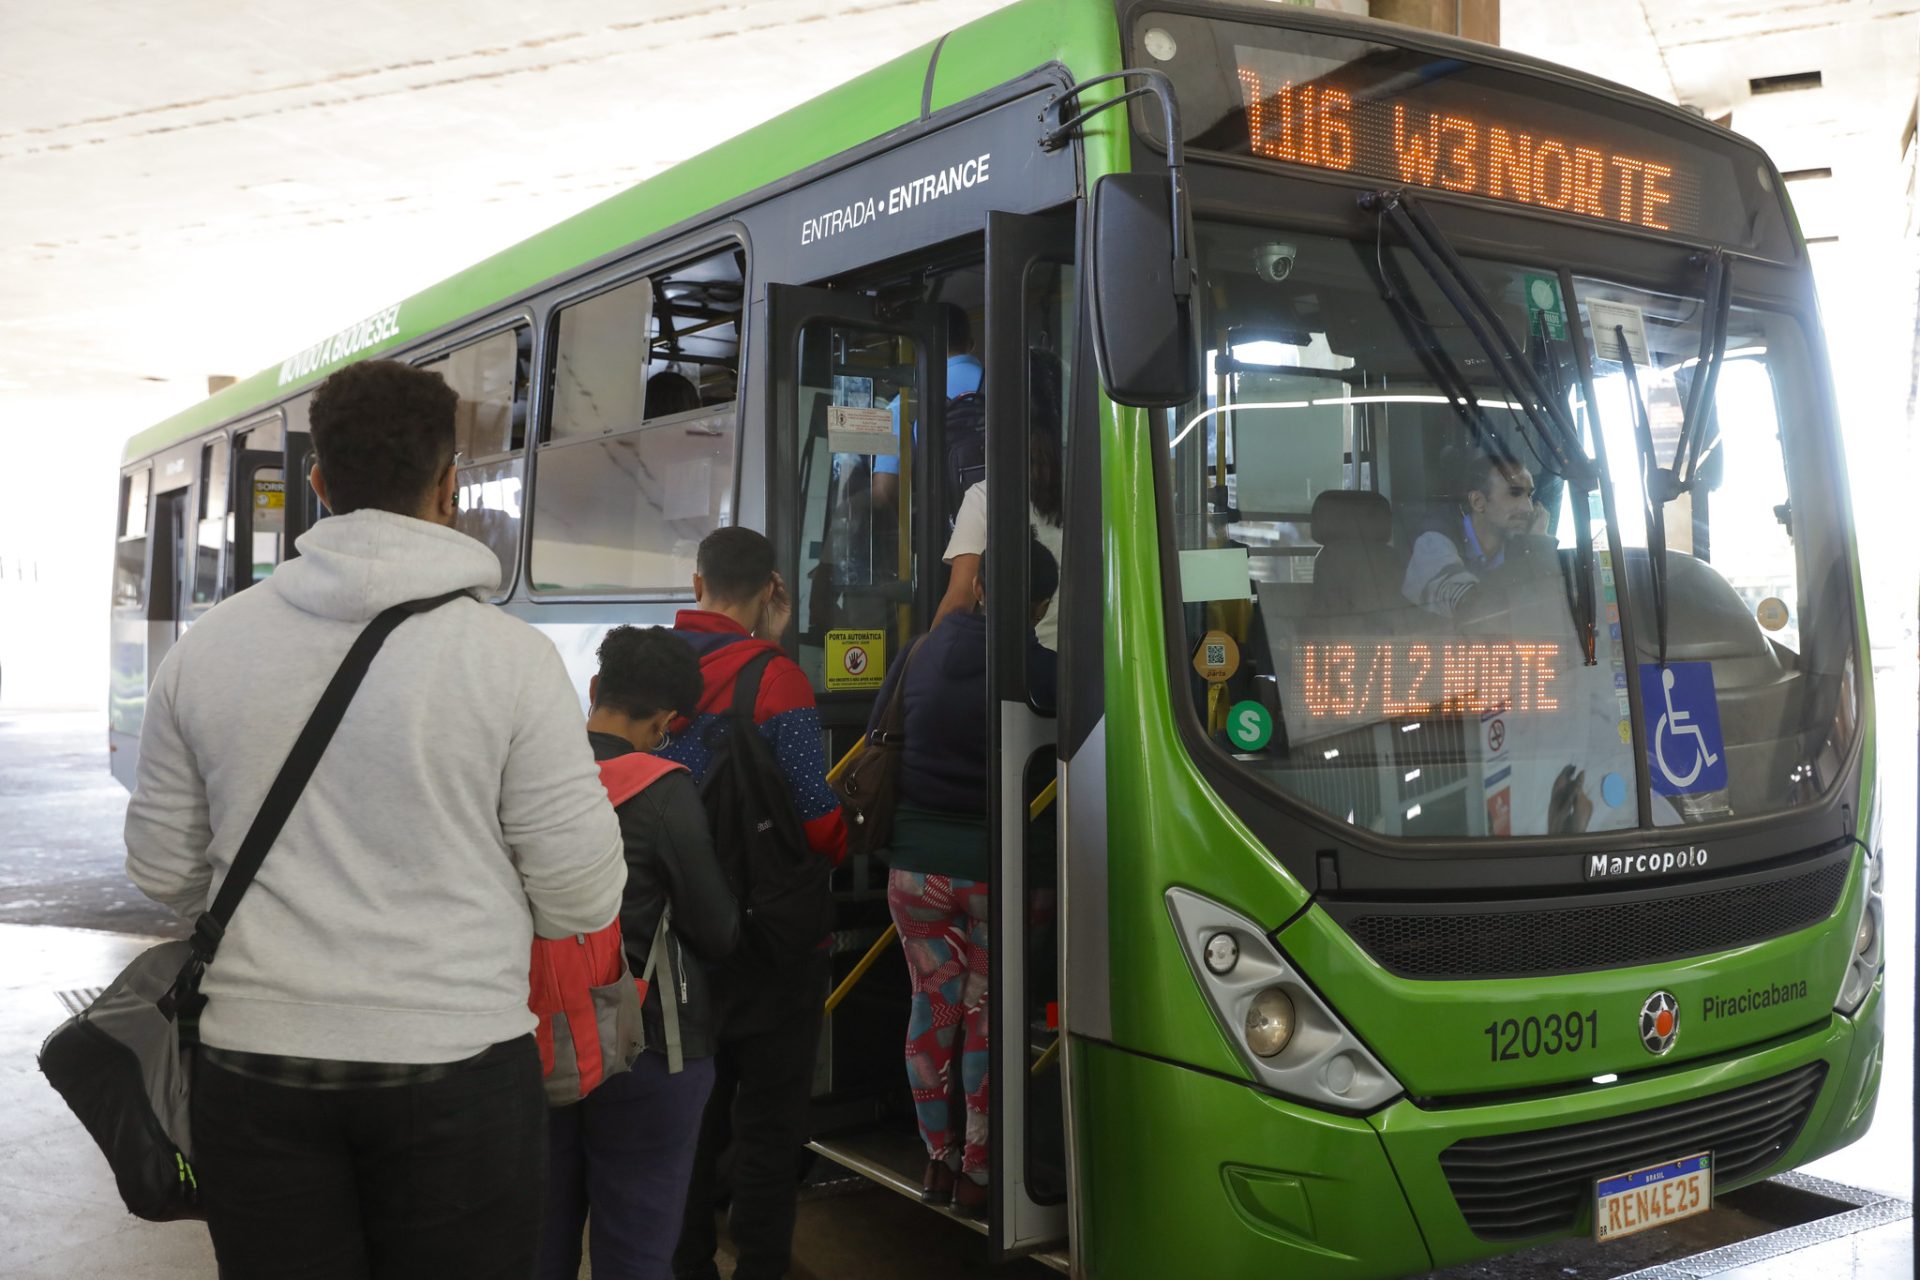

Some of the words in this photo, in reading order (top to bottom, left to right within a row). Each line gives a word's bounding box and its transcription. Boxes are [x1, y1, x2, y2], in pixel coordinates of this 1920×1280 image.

[1395, 104, 1478, 191] W3
[1489, 125, 1673, 231] NORTE
[801, 197, 876, 246] ENTRADA
[888, 152, 991, 216] ENTRANCE
[828, 633, 847, 641] PORTA
[1442, 643, 1559, 713] NORTE
[1237, 709, 1261, 743] S
[1589, 846, 1708, 878] Marcopolo
[1702, 978, 1808, 1021] Piracicabana
[1484, 1009, 1598, 1062] 120391
[1645, 1171, 1665, 1183] BRASIL
[1608, 1175, 1701, 1232] REN4E25
[1600, 1224, 1608, 1236] BR
